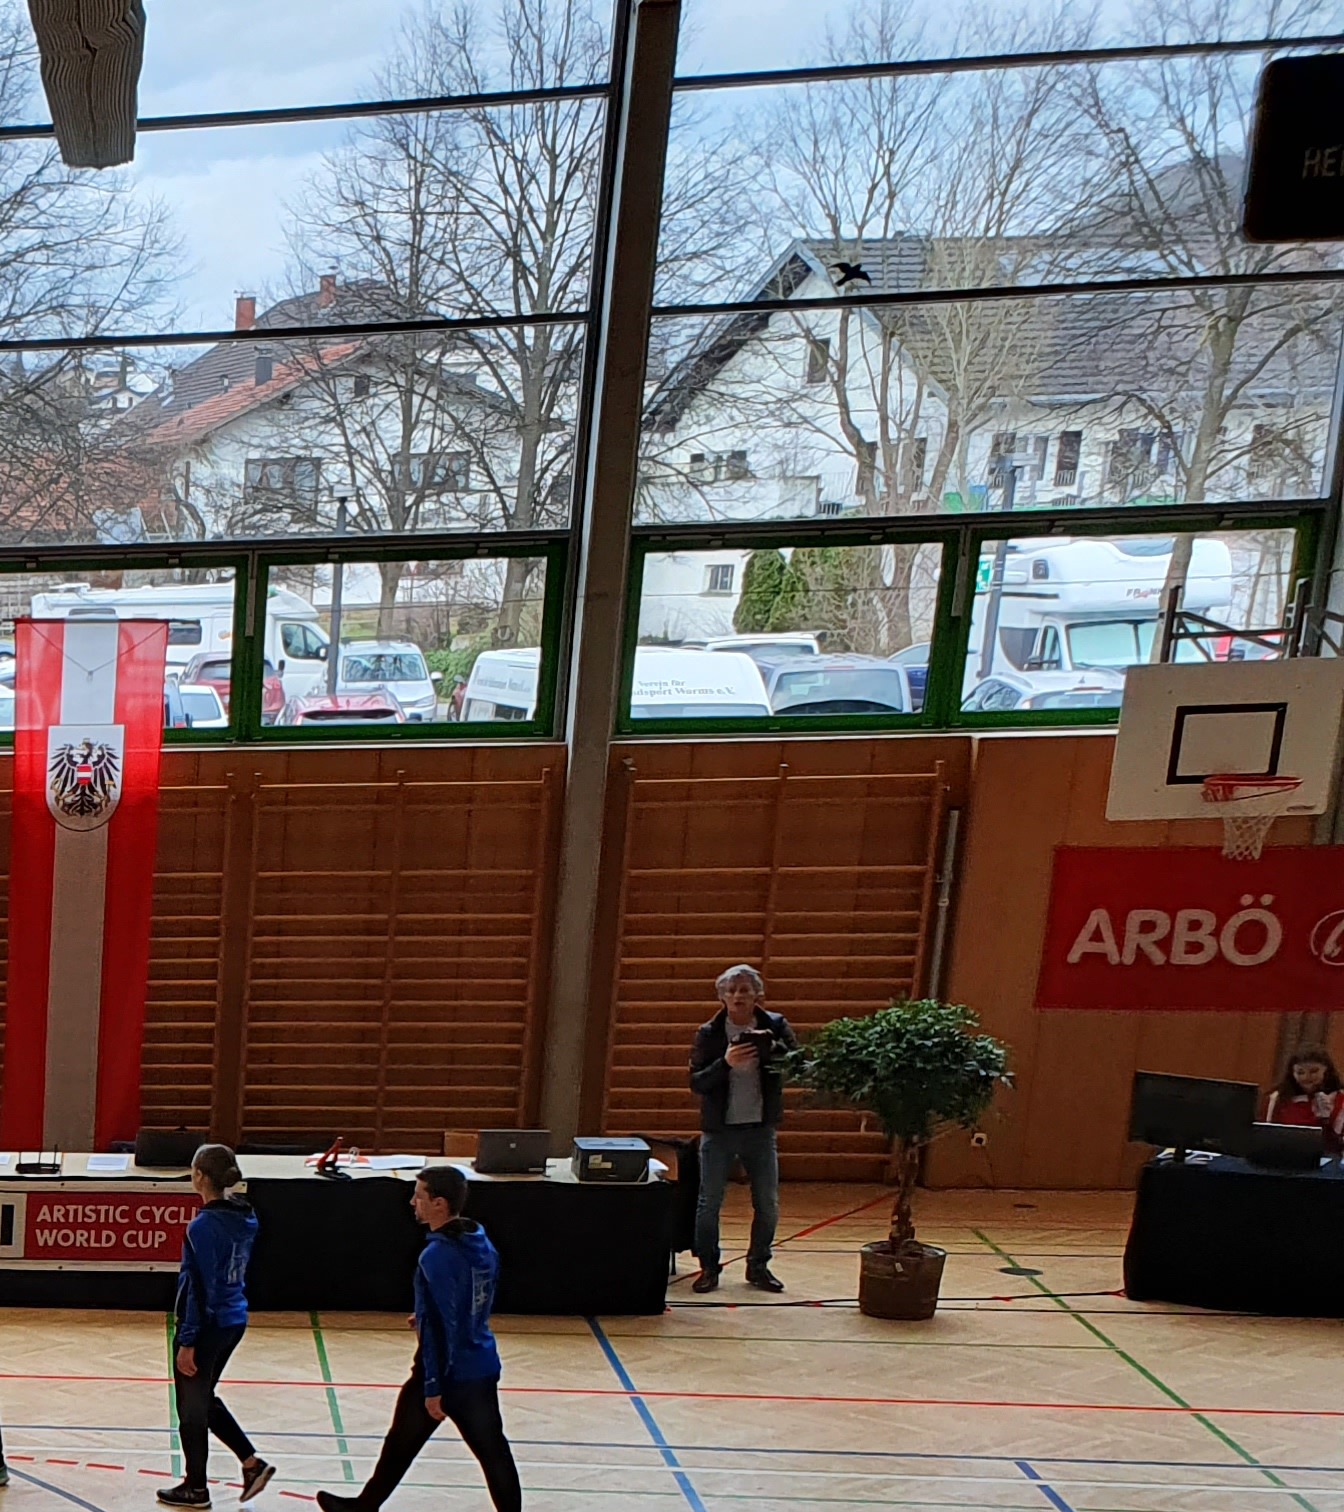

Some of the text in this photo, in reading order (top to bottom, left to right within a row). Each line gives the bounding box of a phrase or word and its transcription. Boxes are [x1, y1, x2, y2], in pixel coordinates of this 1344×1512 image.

[1067, 893, 1283, 967] ARBÖ
[36, 1204, 199, 1224] ARTISTIC CYCLI
[35, 1228, 167, 1249] WORLD CUP
